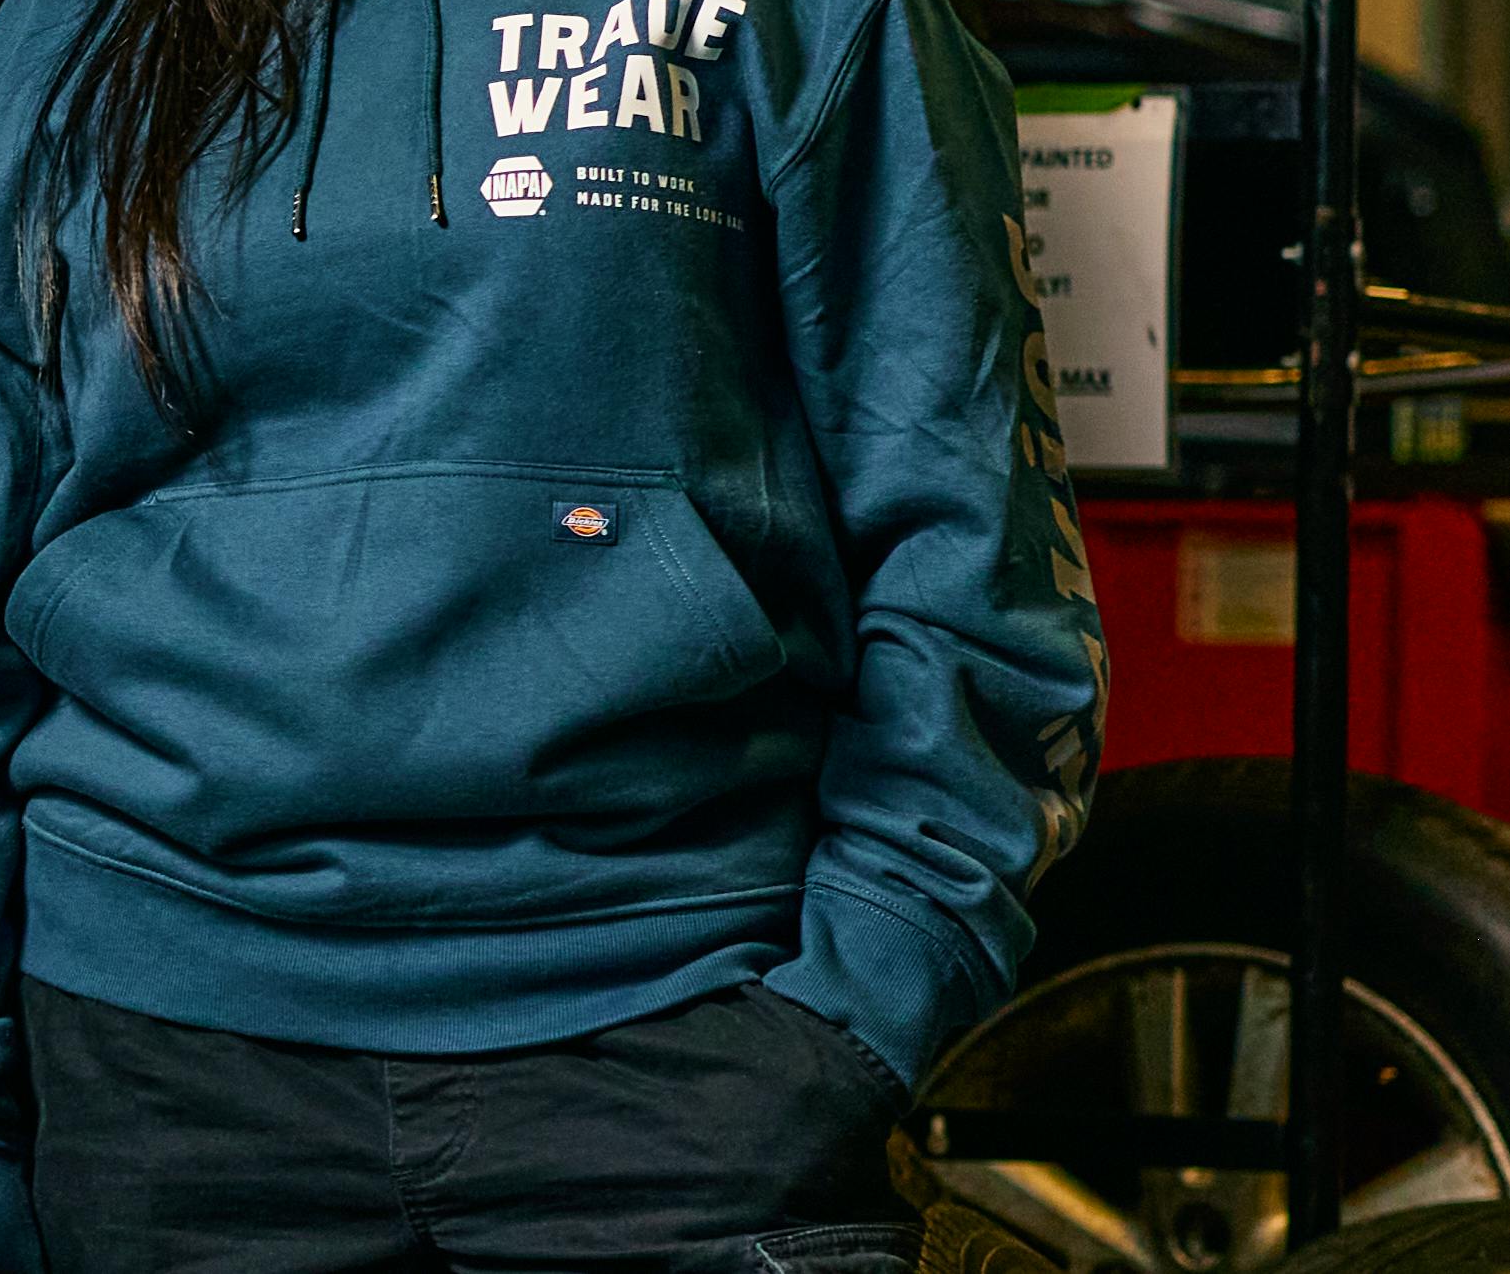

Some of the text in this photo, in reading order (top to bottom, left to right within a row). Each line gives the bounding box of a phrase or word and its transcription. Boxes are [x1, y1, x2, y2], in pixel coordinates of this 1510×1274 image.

[488, 54, 702, 142] WEAR
[493, 172, 542, 200] NAPA
[576, 166, 694, 193] BUILT TO WORK
[576, 191, 623, 208] MADE
[631, 196, 660, 212] FOR
[665, 200, 690, 217] THE
[695, 206, 723, 225] LONG
